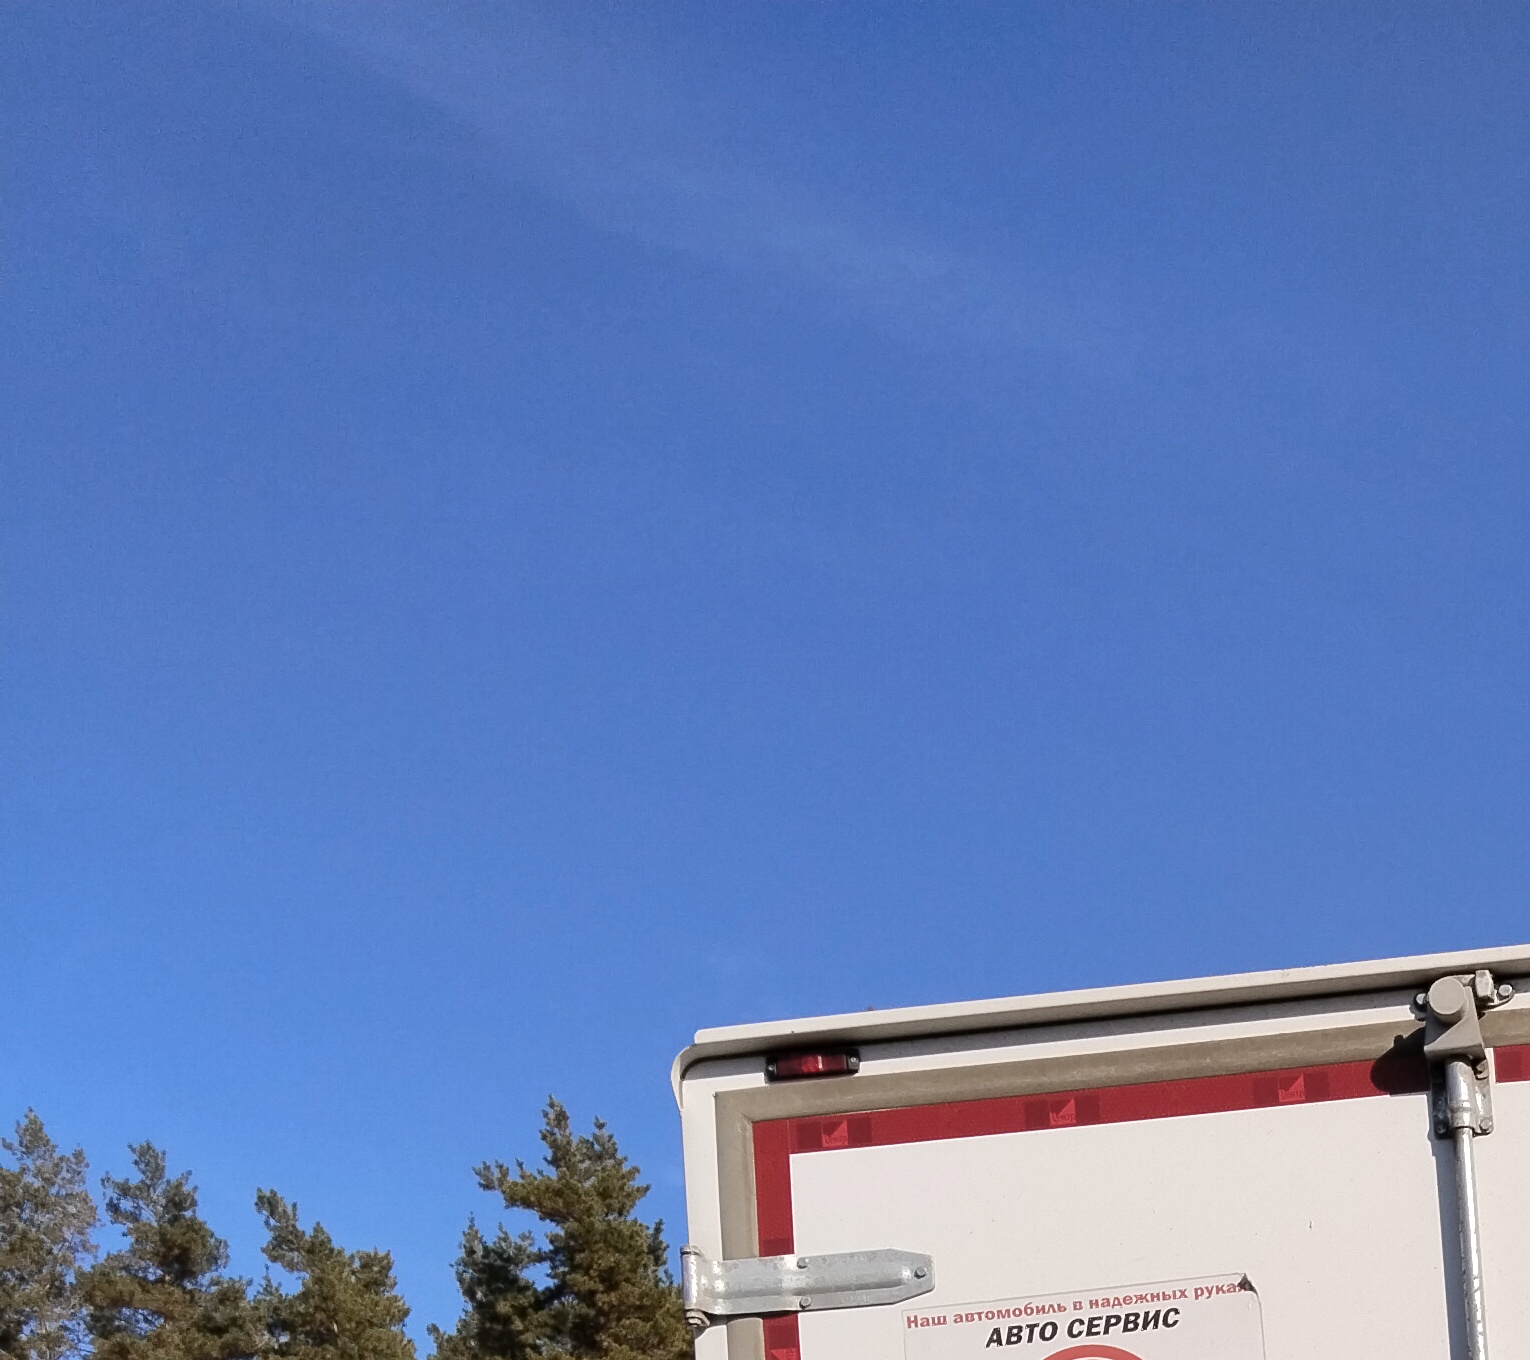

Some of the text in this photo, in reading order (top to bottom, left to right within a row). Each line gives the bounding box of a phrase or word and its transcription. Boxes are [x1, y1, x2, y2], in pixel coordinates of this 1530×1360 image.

[906, 1314, 947, 1329] Наш
[953, 1301, 1067, 1324] автомобиль
[1072, 1300, 1084, 1311] в
[1088, 1288, 1188, 1309] надежных
[985, 1307, 1181, 1349] АВТО СЕРВИС
